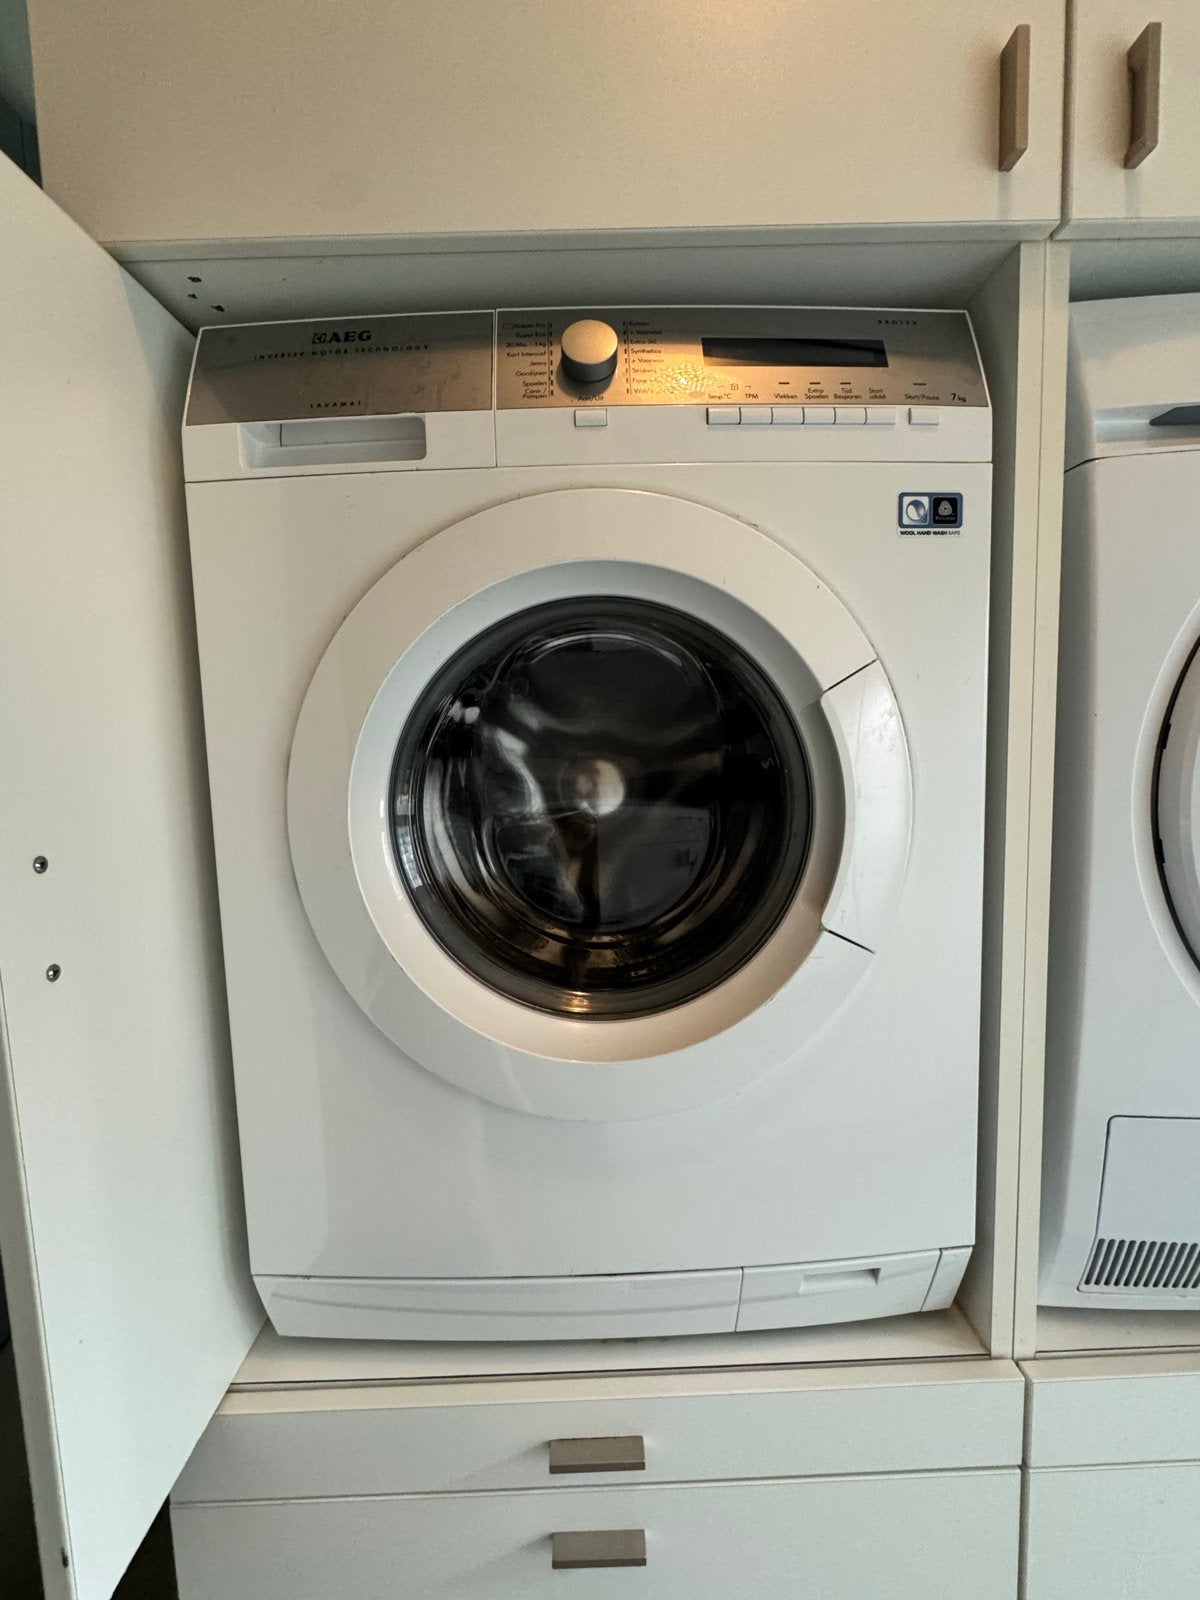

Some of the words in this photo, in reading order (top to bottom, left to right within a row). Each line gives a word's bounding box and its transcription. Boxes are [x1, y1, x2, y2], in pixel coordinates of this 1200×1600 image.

[328, 330, 372, 343] AEG
[254, 352, 305, 360] INVERTER
[355, 344, 429, 354] TECHNOLOGY
[950, 392, 957, 401] 7
[310, 401, 363, 409] LAVAMAT
